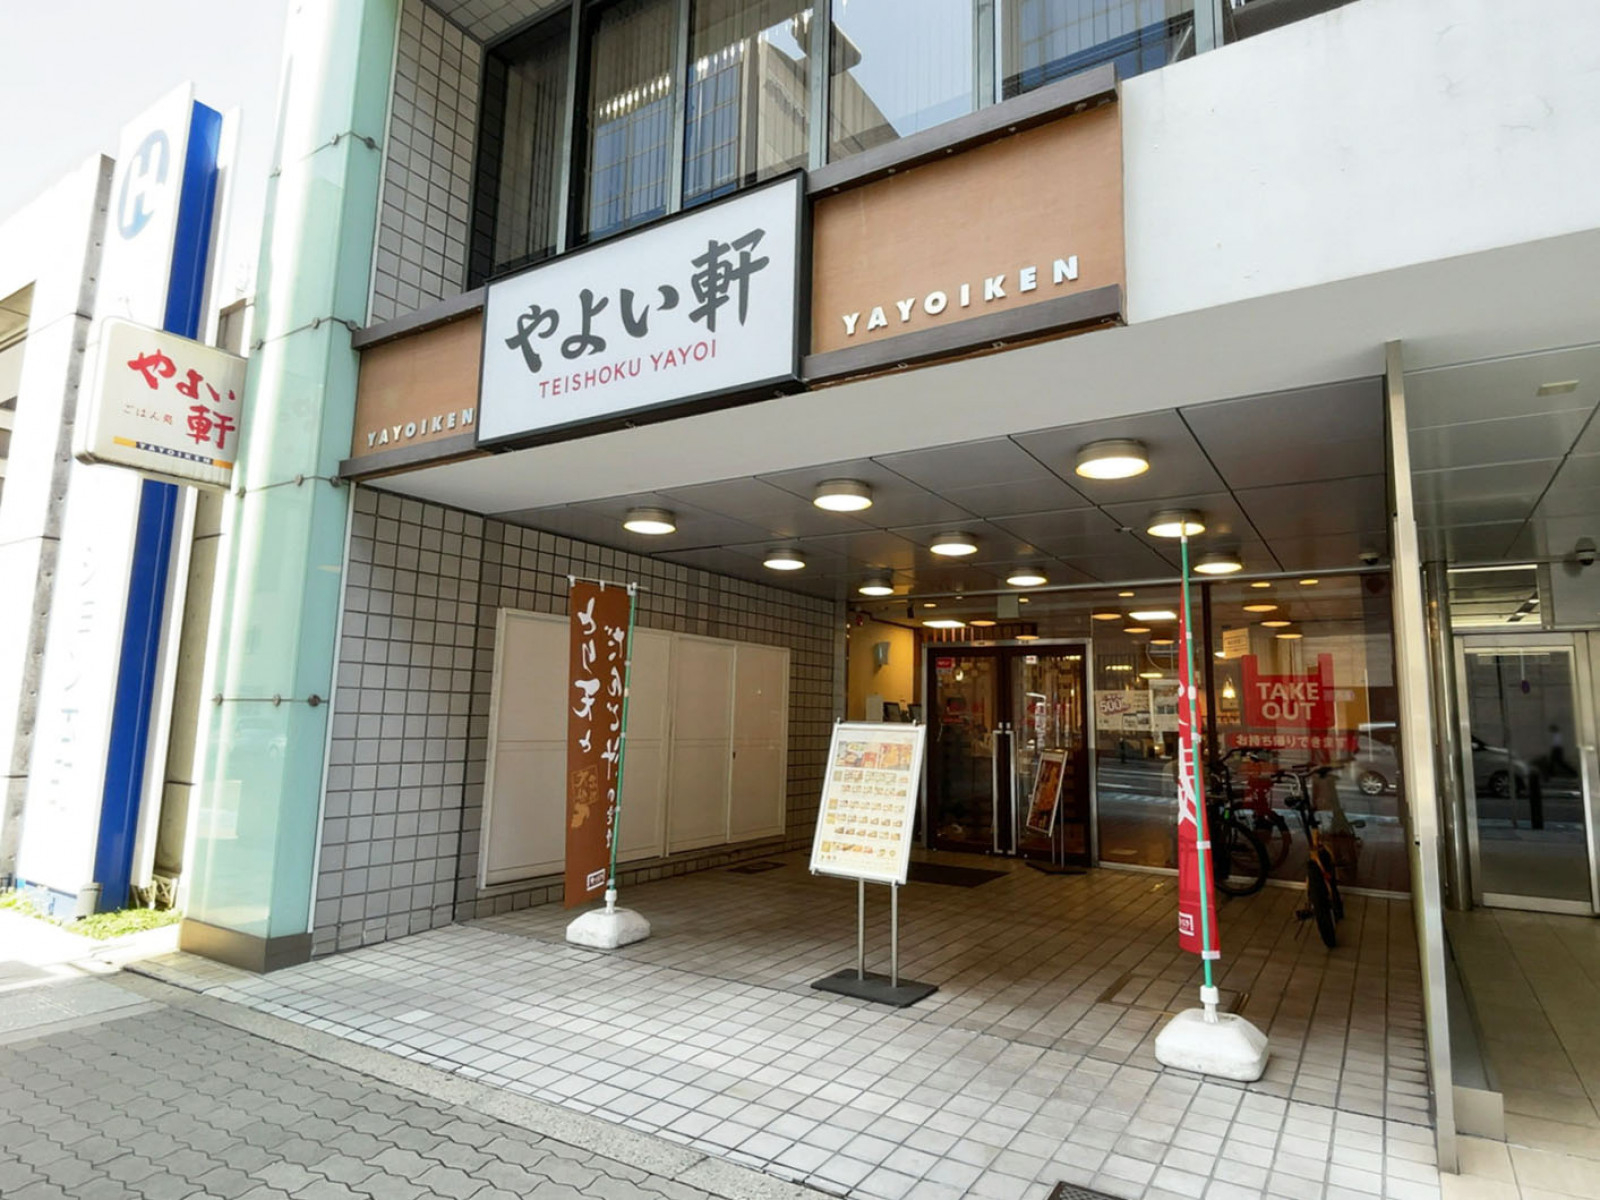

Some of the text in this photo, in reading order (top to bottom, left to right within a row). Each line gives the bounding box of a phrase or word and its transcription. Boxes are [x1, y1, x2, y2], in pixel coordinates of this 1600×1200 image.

[505, 228, 770, 373] やよい軒
[841, 254, 1079, 336] YAYOIKEN
[538, 338, 718, 399] TEISHOKU YAYOI
[367, 407, 475, 448] YAYOIKEN
[138, 442, 213, 465] YAYOIKEN
[1256, 682, 1320, 700] TAKE
[1261, 701, 1317, 720] OUT
